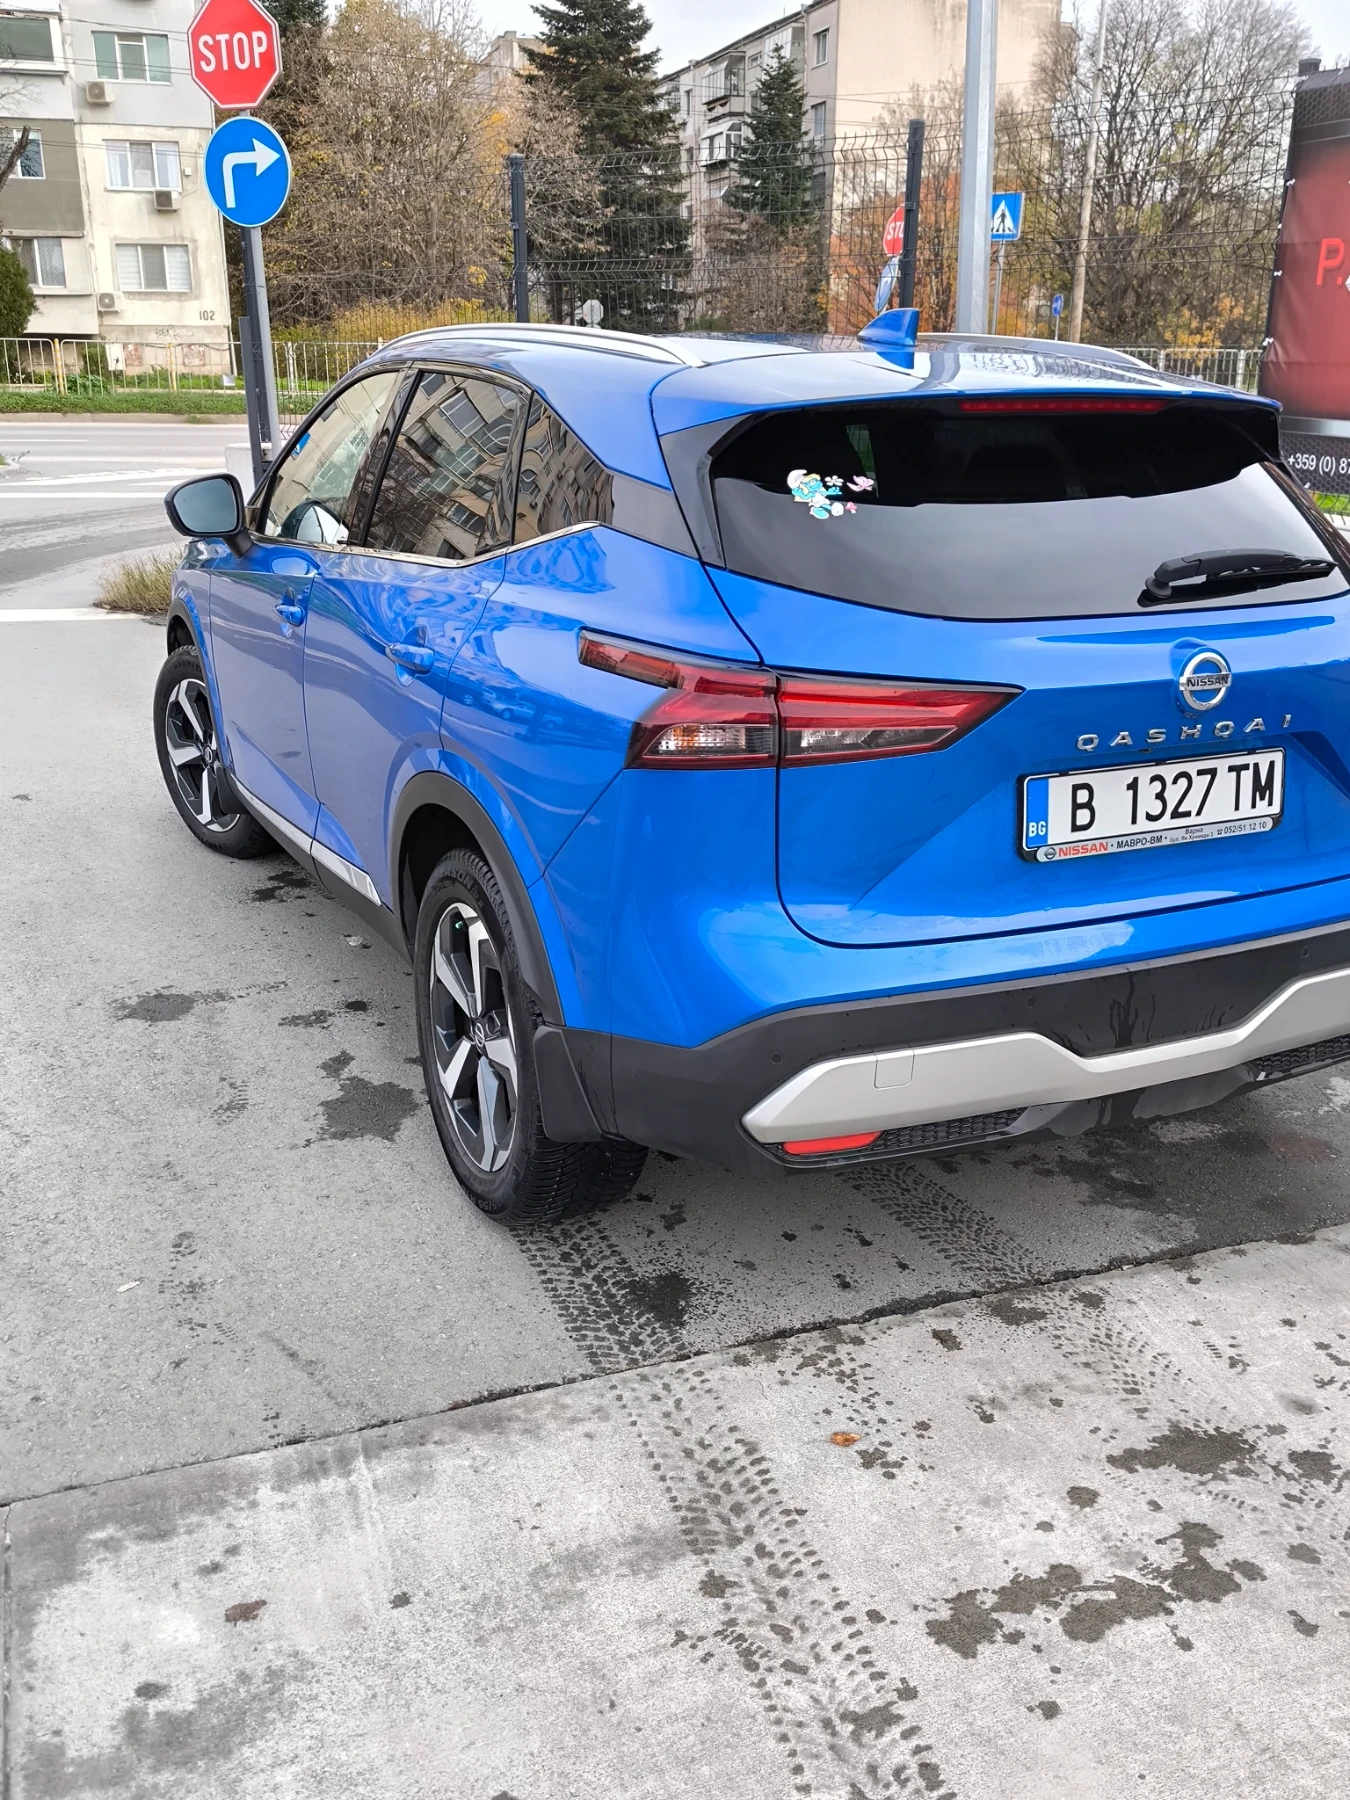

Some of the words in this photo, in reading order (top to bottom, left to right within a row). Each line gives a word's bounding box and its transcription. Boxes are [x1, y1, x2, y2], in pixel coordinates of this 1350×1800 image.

[198, 30, 268, 73] STOP
[199, 310, 215, 321] 102
[1288, 453, 1317, 470] +359
[1319, 455, 1336, 476] (0)
[1186, 673, 1230, 687] NISSAN
[1076, 714, 1292, 752] QASHQAI
[1070, 782, 1096, 833] B
[1126, 766, 1218, 826] 1327
[1228, 760, 1276, 812] TM
[1028, 820, 1047, 837] BG
[1249, 822, 1257, 831] 12
[1259, 821, 1267, 829] 10
[1058, 841, 1109, 857] NISSAN
